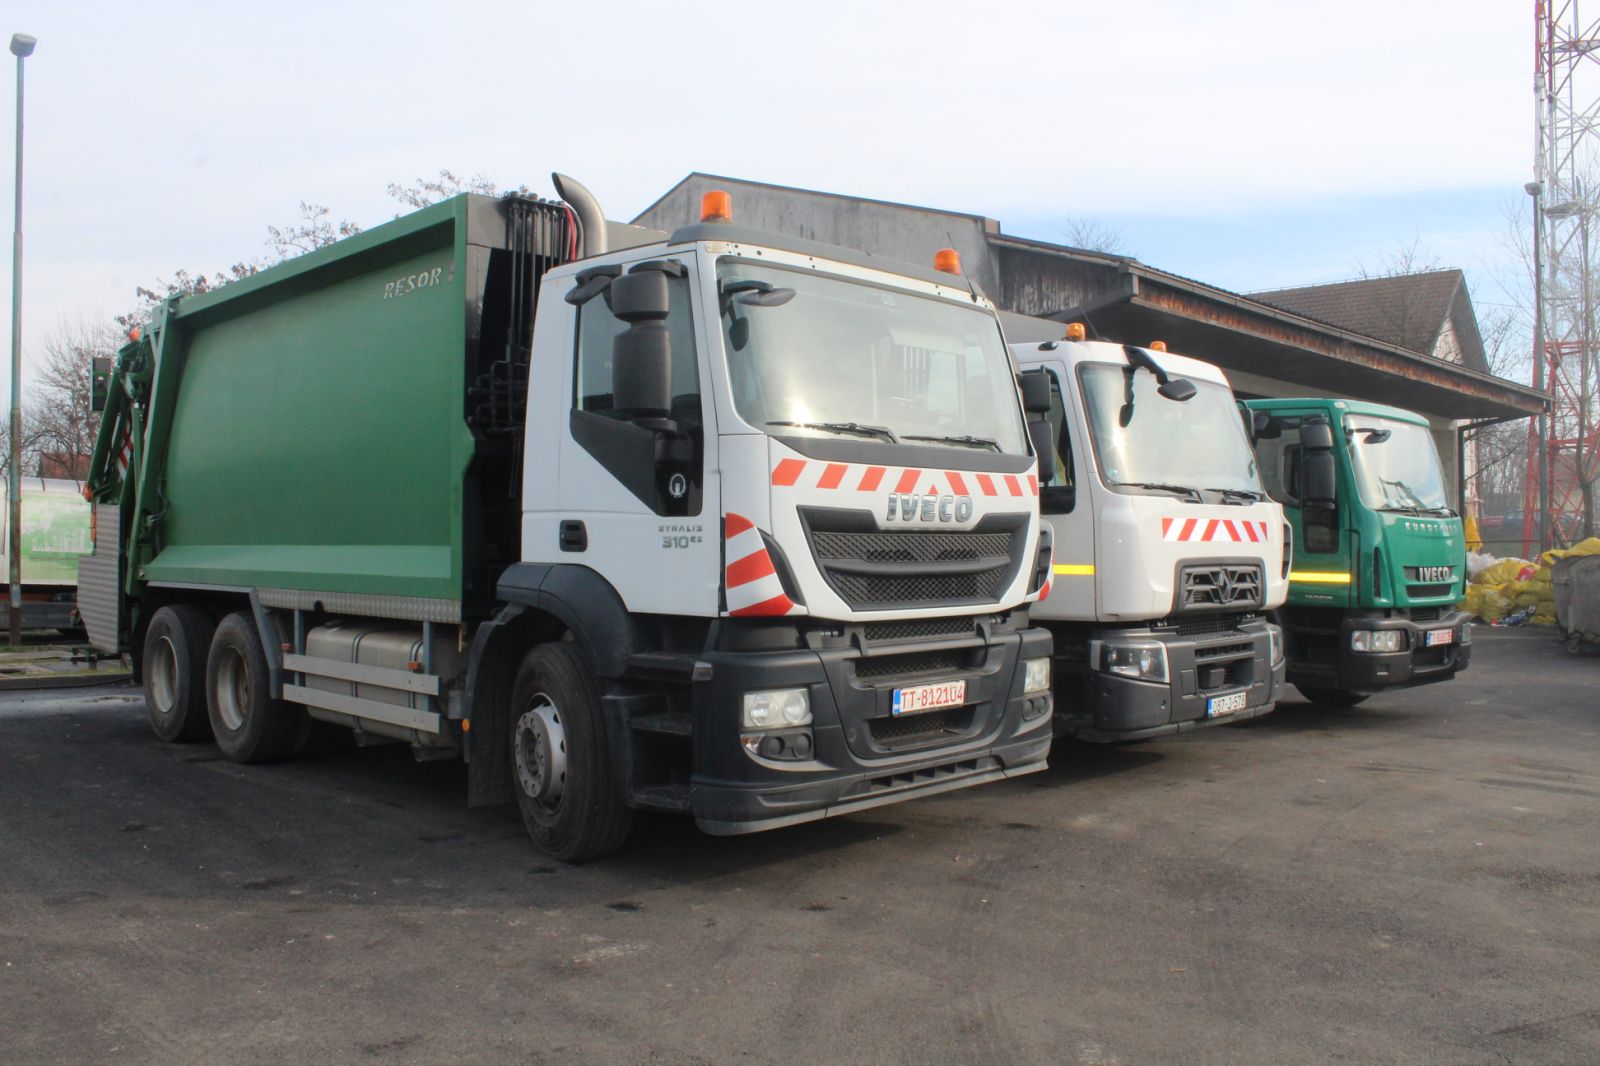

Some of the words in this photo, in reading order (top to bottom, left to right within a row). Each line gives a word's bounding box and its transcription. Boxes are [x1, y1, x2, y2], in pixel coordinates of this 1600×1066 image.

[383, 267, 442, 300] RESOR
[886, 493, 973, 523] IVECO
[658, 525, 703, 533] STRALIS
[1419, 566, 1449, 583] IVECO
[901, 685, 963, 710] TT-812104
